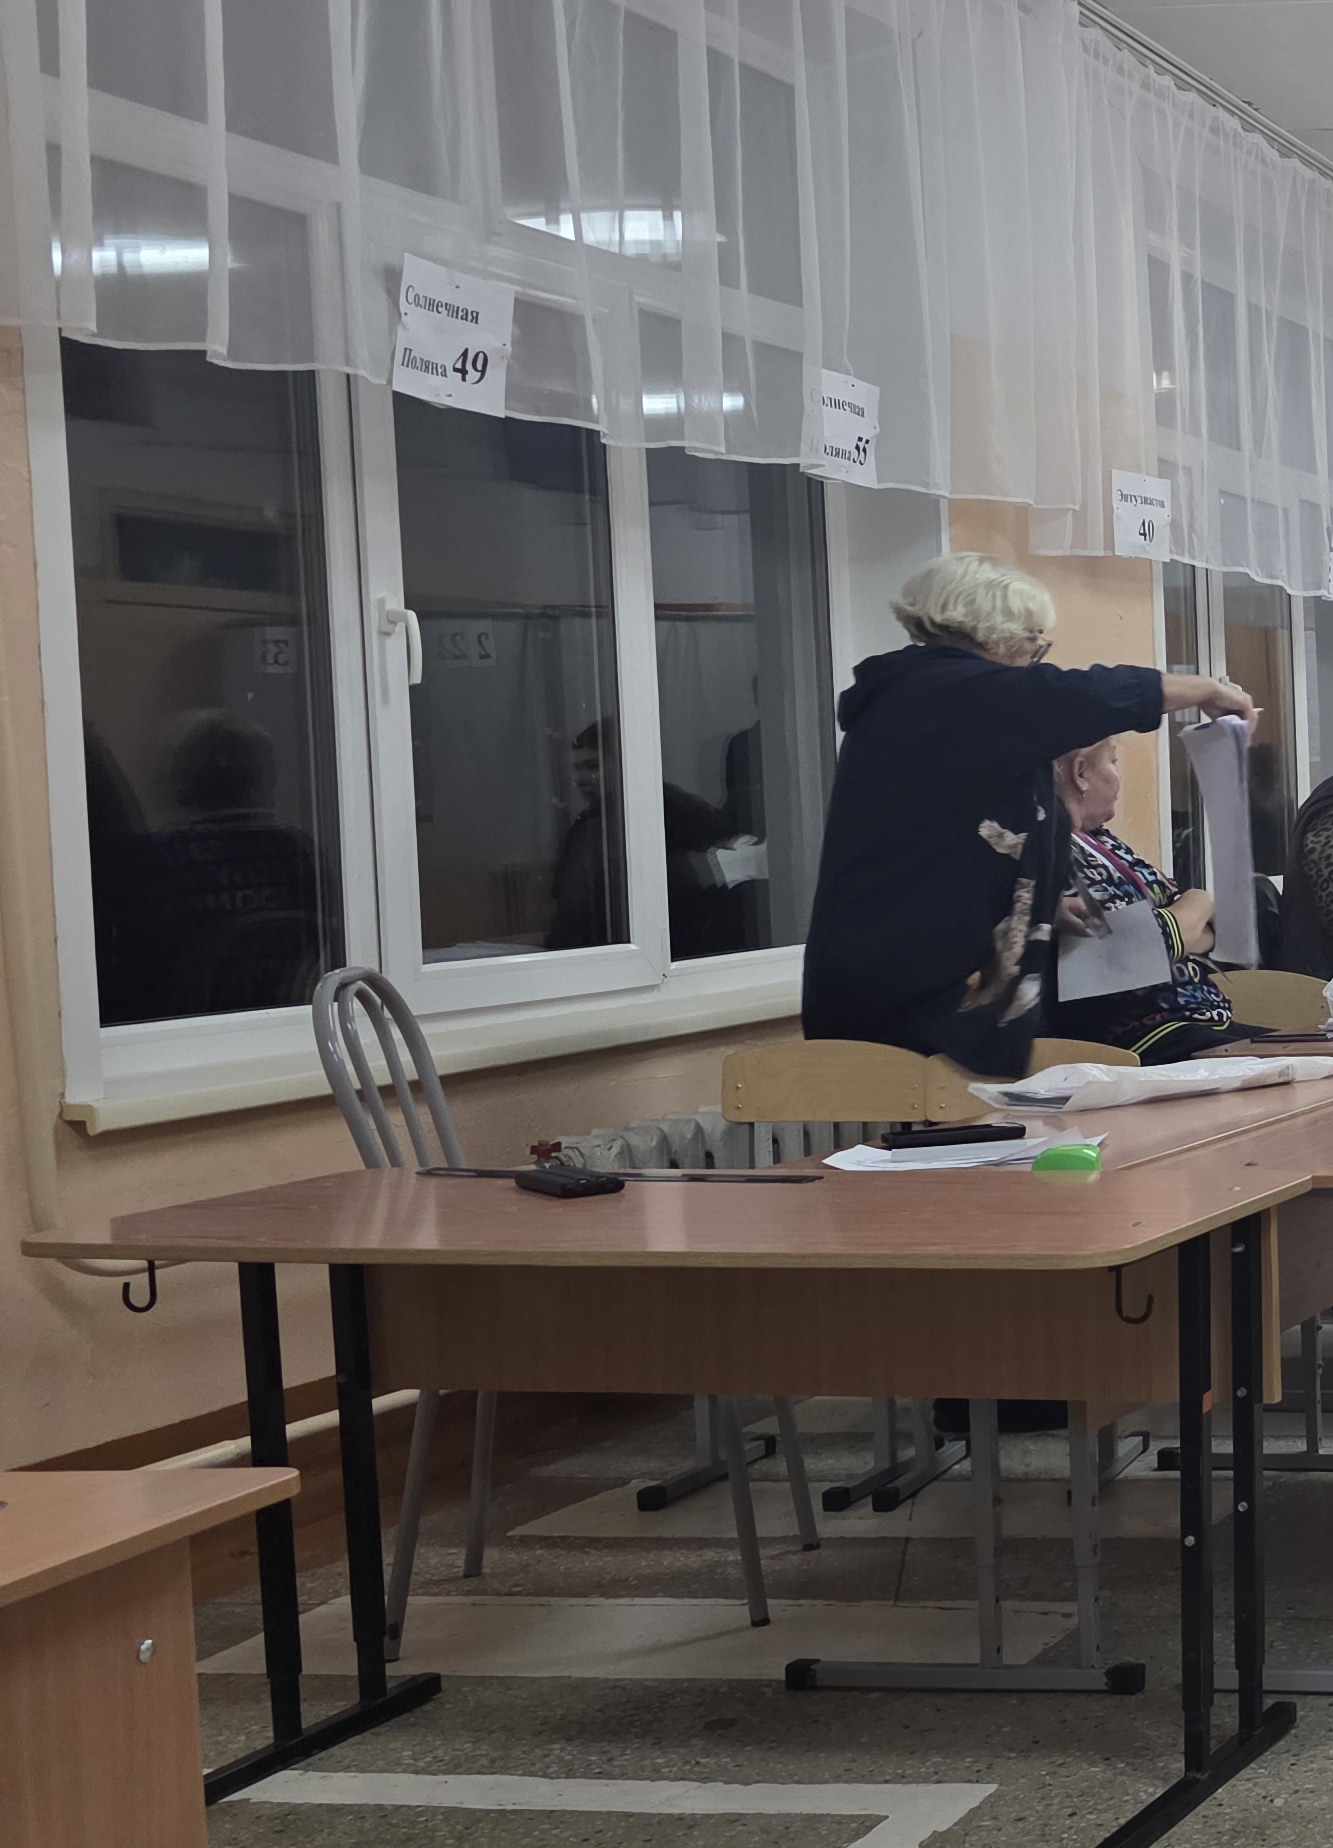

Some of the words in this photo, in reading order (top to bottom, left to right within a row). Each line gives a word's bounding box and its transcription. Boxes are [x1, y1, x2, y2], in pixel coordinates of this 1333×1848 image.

[405, 284, 480, 325] Солнечная
[400, 346, 448, 379] Поляна
[452, 347, 489, 385] 49
[852, 436, 870, 466] 55
[1138, 518, 1155, 543] 40
